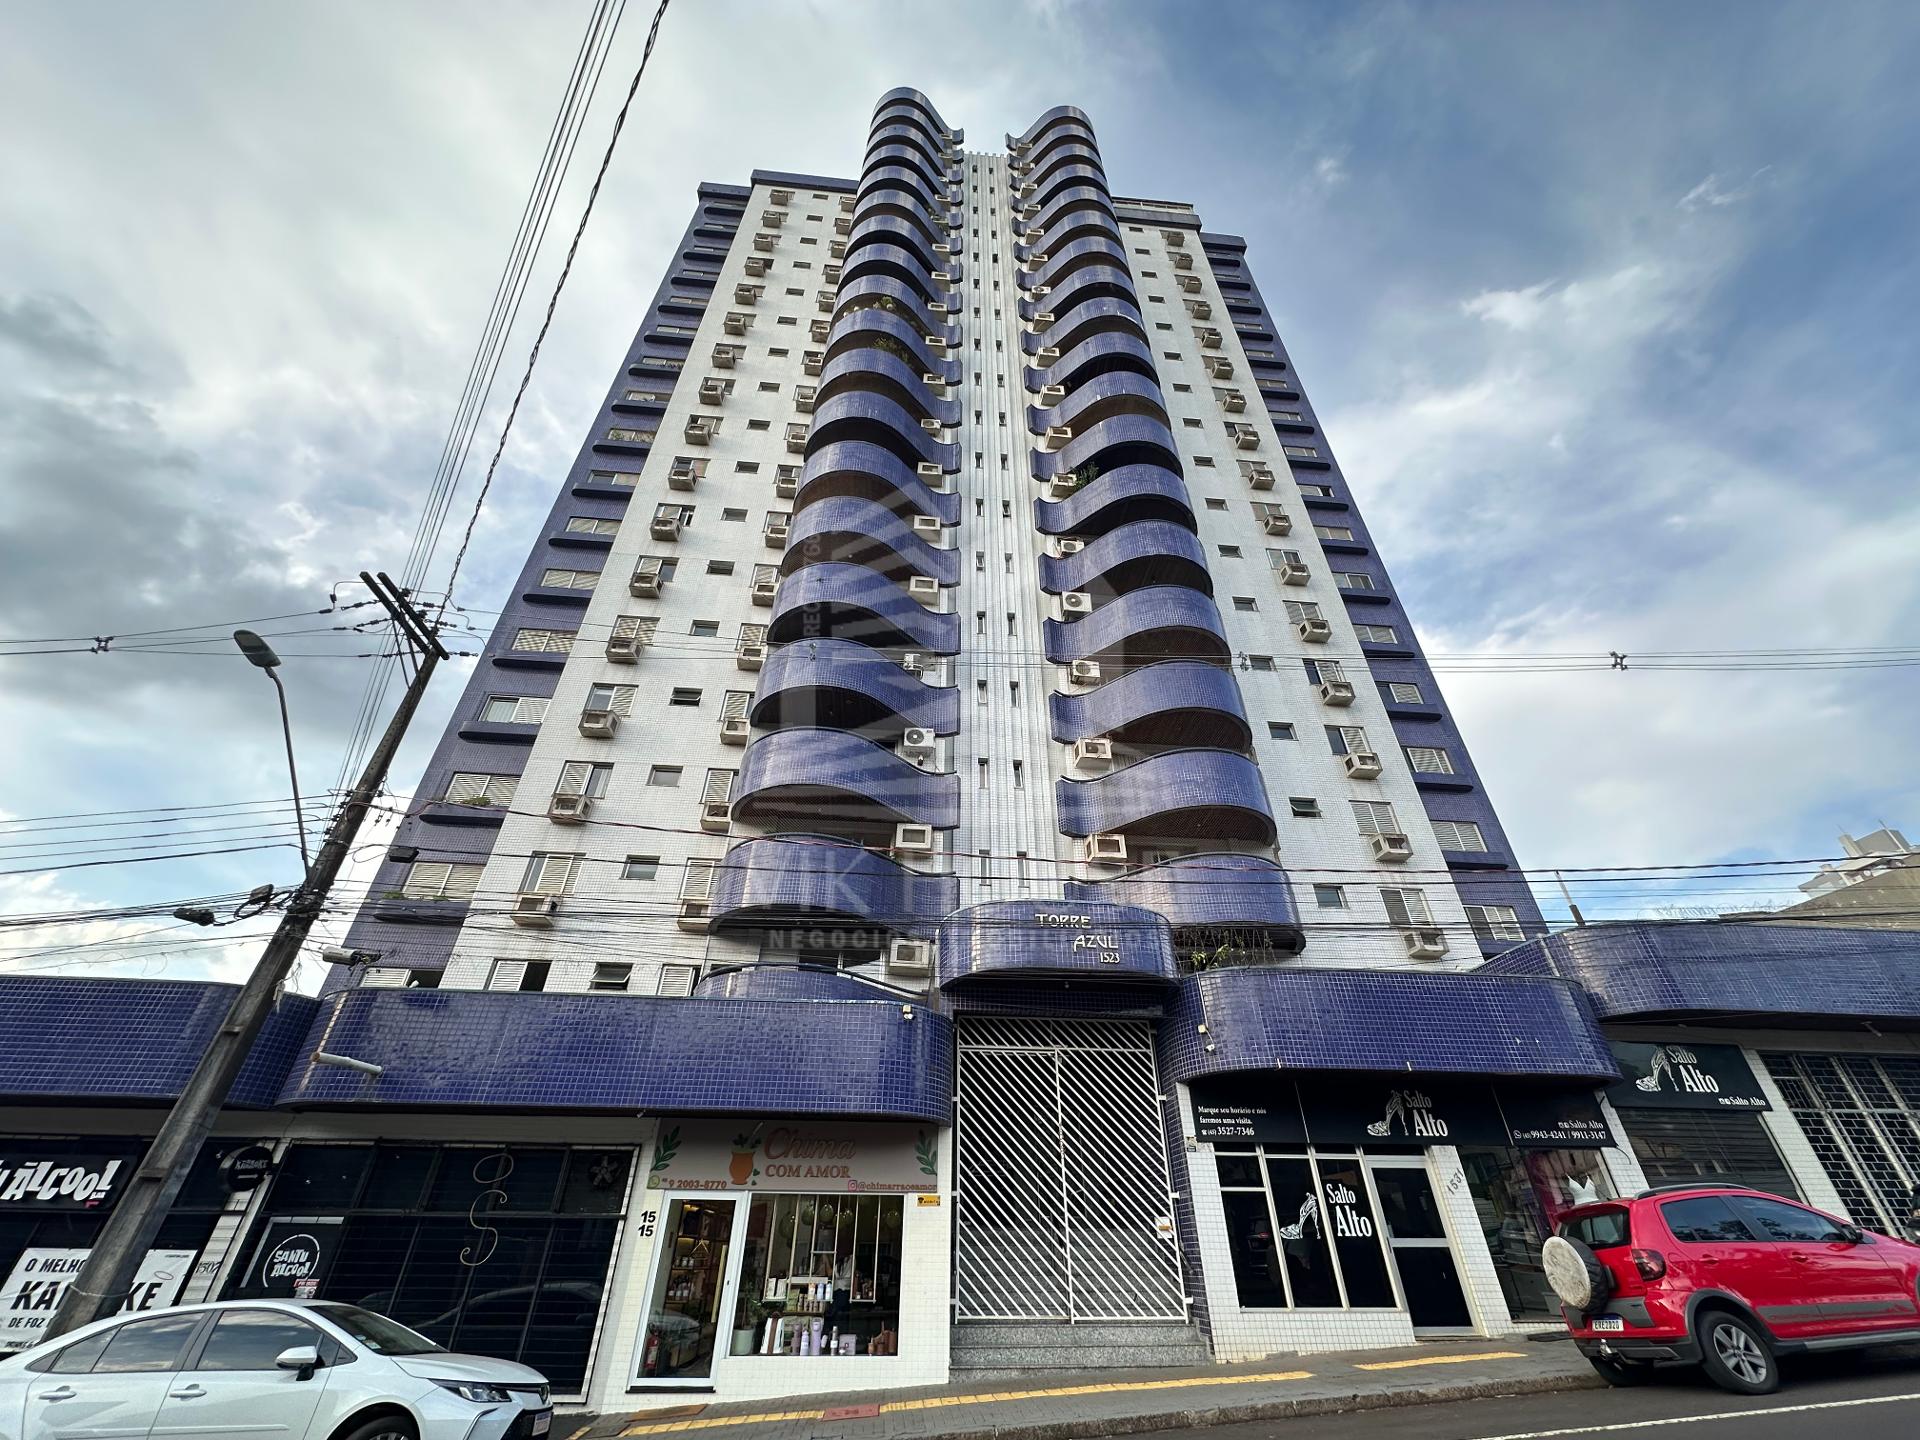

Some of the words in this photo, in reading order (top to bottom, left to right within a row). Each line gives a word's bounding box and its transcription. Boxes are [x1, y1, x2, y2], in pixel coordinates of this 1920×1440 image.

[1034, 913, 1092, 929] TORRE
[1073, 934, 1119, 952] AZUL
[1099, 952, 1120, 963] 1523
[1665, 1045, 1697, 1064] Salto
[1679, 1065, 1720, 1093] Alto
[1403, 1089, 1432, 1108] Salto
[1730, 1096, 1749, 1105] Salto
[1750, 1097, 1766, 1106] Alto
[1197, 1105, 1219, 1115] Marque
[1199, 1115, 1222, 1124] faremos
[1413, 1109, 1448, 1137] Alto
[1569, 1119, 1587, 1129] Salto
[1588, 1120, 1603, 1129] Alto
[1217, 1126, 1255, 1136] 3527-7346
[764, 1127, 857, 1160] Chima
[765, 1165, 800, 1178] COM
[804, 1165, 852, 1179] AMOR
[1446, 1168, 1463, 1195] 1531
[1326, 1183, 1356, 1204] Salto
[640, 1210, 656, 1224] 15
[1335, 1205, 1372, 1237] Alto
[637, 1225, 654, 1237] 15
[25, 1258, 38, 1273] O
[8, 1317, 23, 1328] DE
[24, 1317, 45, 1328] FOZ
